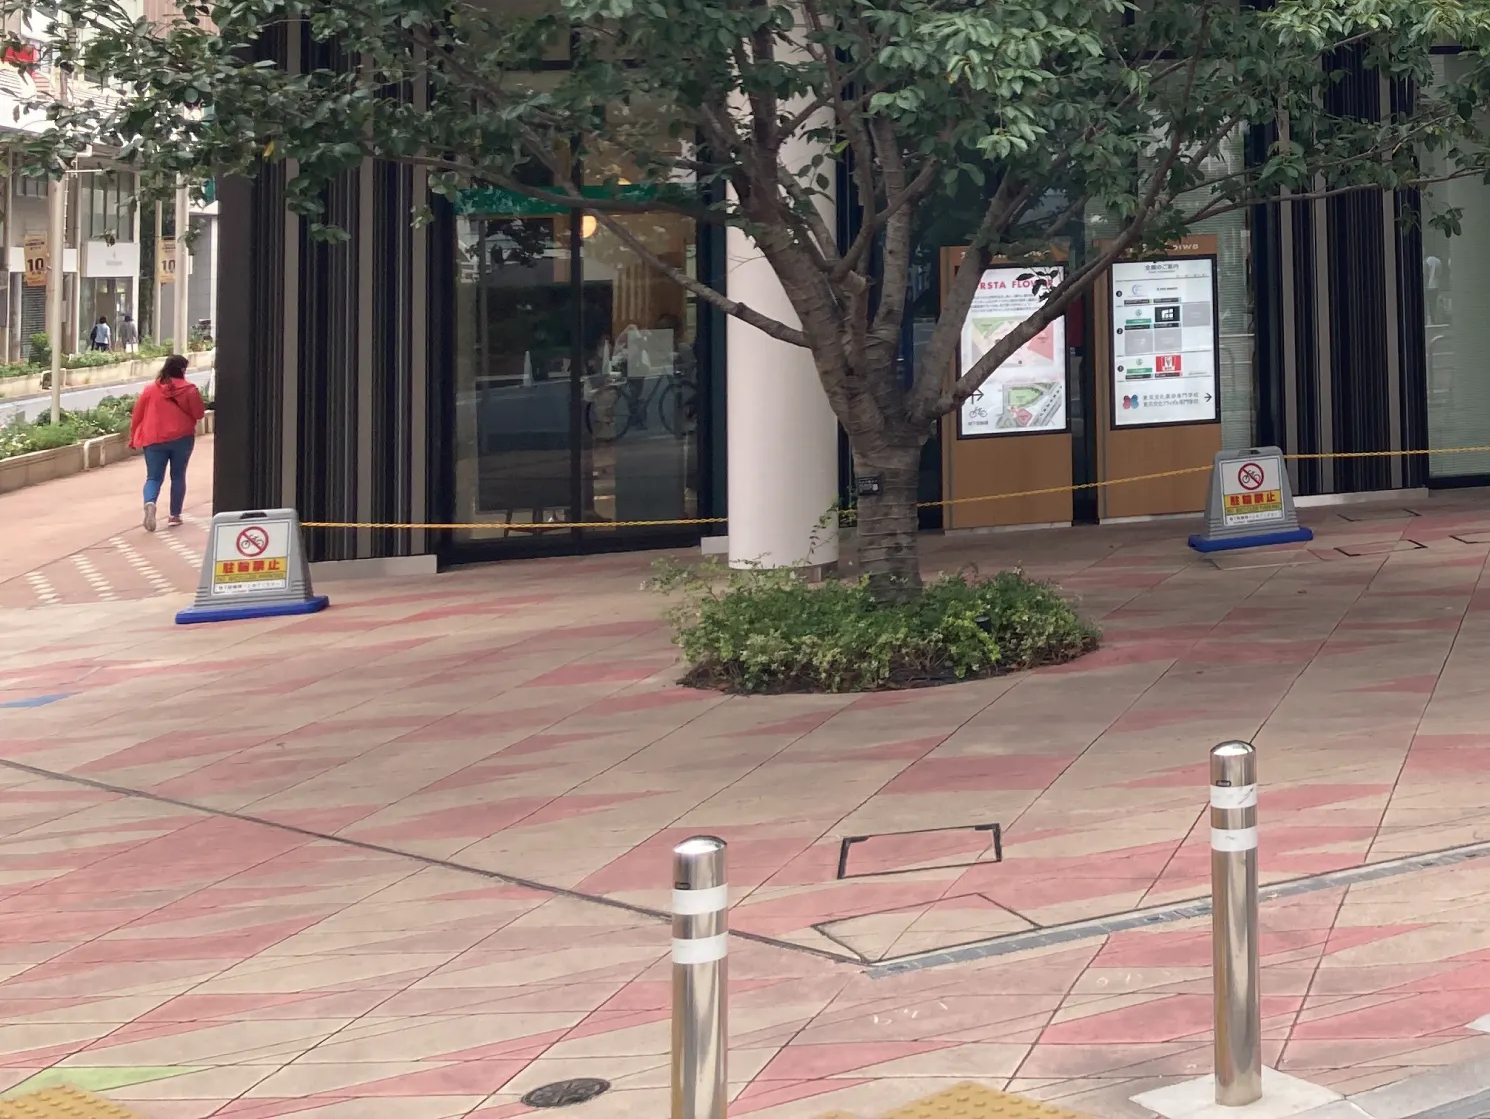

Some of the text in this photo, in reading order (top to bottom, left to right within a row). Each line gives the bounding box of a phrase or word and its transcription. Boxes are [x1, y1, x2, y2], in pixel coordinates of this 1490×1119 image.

[27, 258, 44, 272] 10
[162, 259, 176, 271] 10
[1230, 491, 1277, 506] 駐輪禁止
[222, 559, 280, 574] 駐輪禁止
